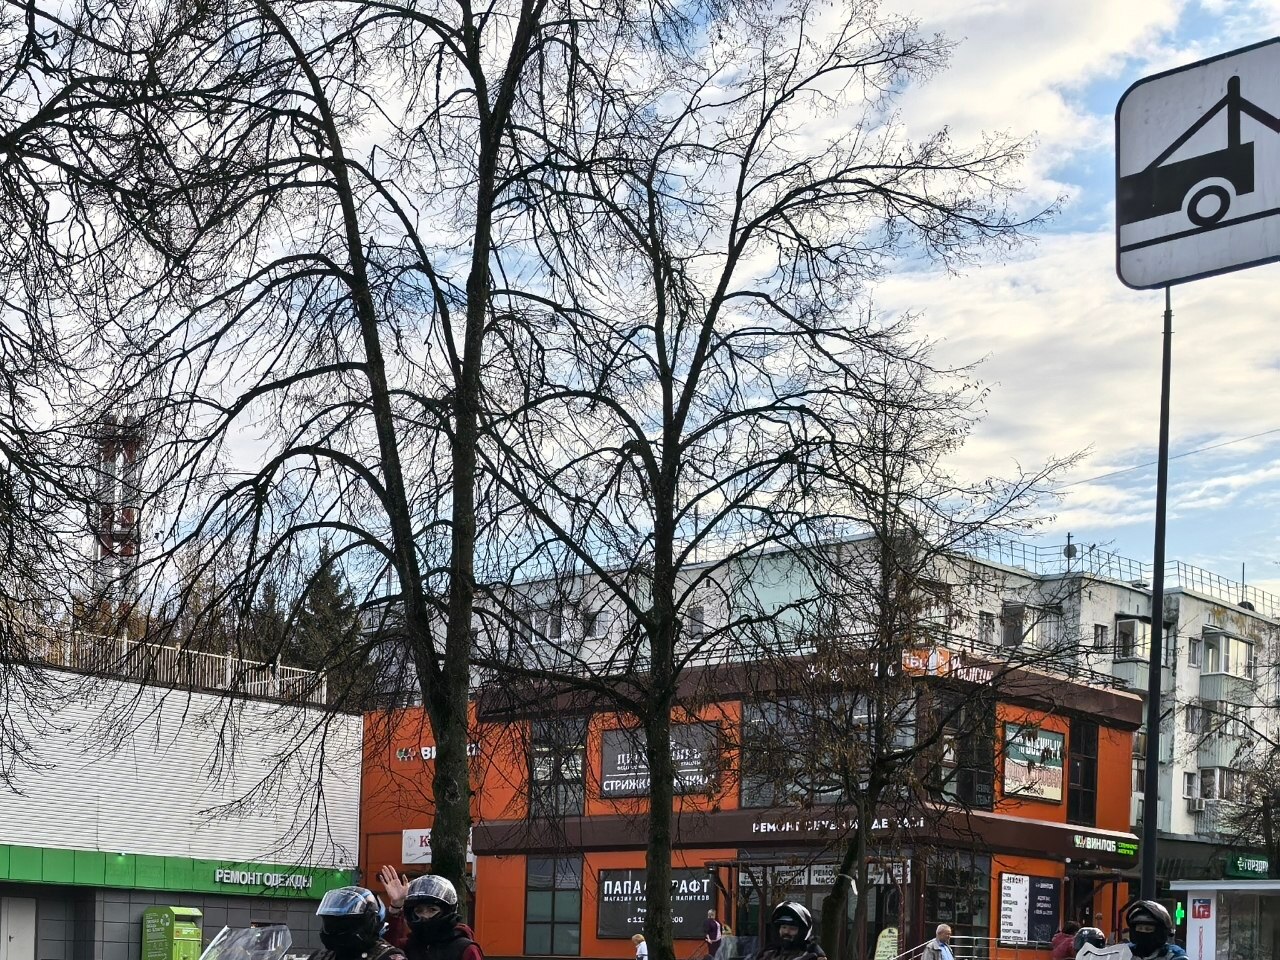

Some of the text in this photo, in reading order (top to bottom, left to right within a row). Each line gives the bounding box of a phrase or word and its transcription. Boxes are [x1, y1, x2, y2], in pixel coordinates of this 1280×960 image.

[215, 869, 313, 889] РЕМОНТ ОДЕЖДЫ
[604, 880, 642, 895] ПАПА
